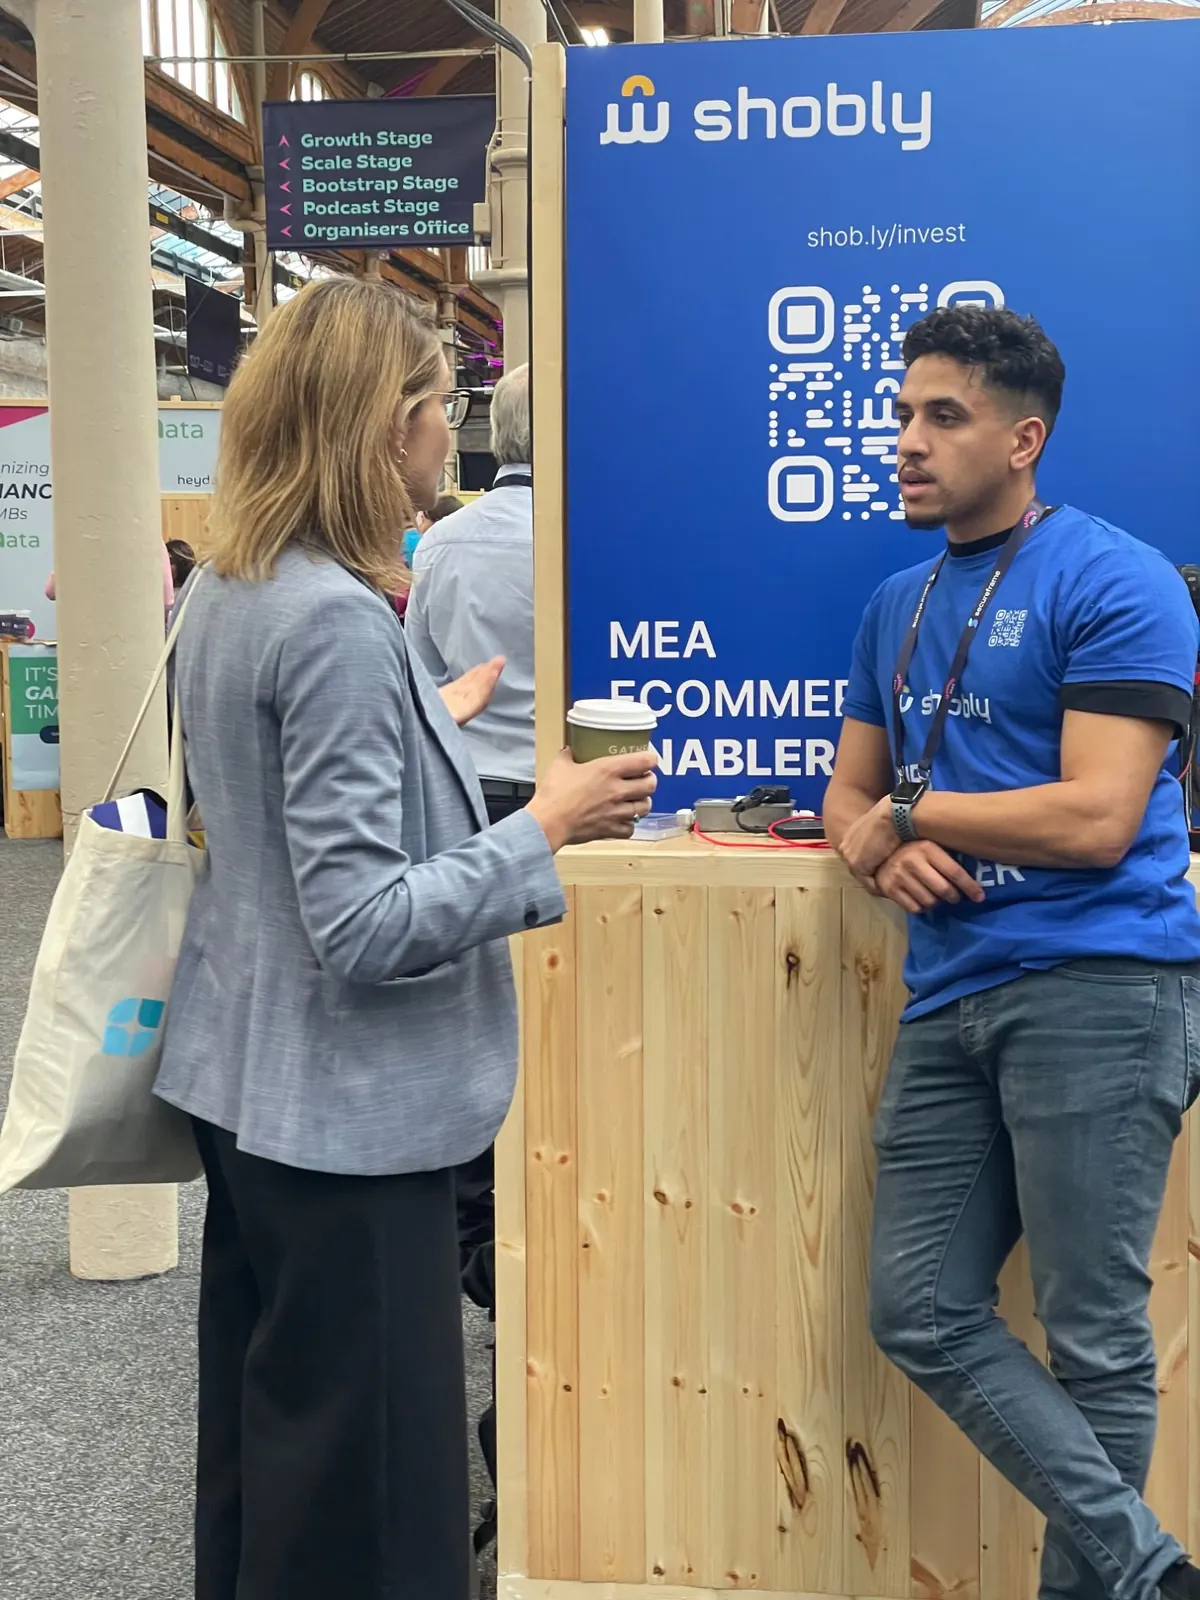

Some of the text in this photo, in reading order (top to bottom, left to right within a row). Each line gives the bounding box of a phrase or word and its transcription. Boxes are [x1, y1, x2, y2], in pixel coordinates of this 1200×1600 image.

[694, 81, 932, 151] shobly
[301, 131, 433, 148] Growth Stage
[301, 154, 413, 172] Scale Stage
[302, 175, 459, 194] Bootstrap Stage
[303, 198, 440, 216] Podcast Stage
[303, 220, 469, 241] Organisers Office
[807, 222, 966, 250] shob.ly/invest
[177, 475, 214, 487] heyd
[974, 570, 1001, 617] secureframe
[610, 621, 717, 658] MEA
[25, 685, 60, 700] GA
[648, 739, 836, 776] NABLER
